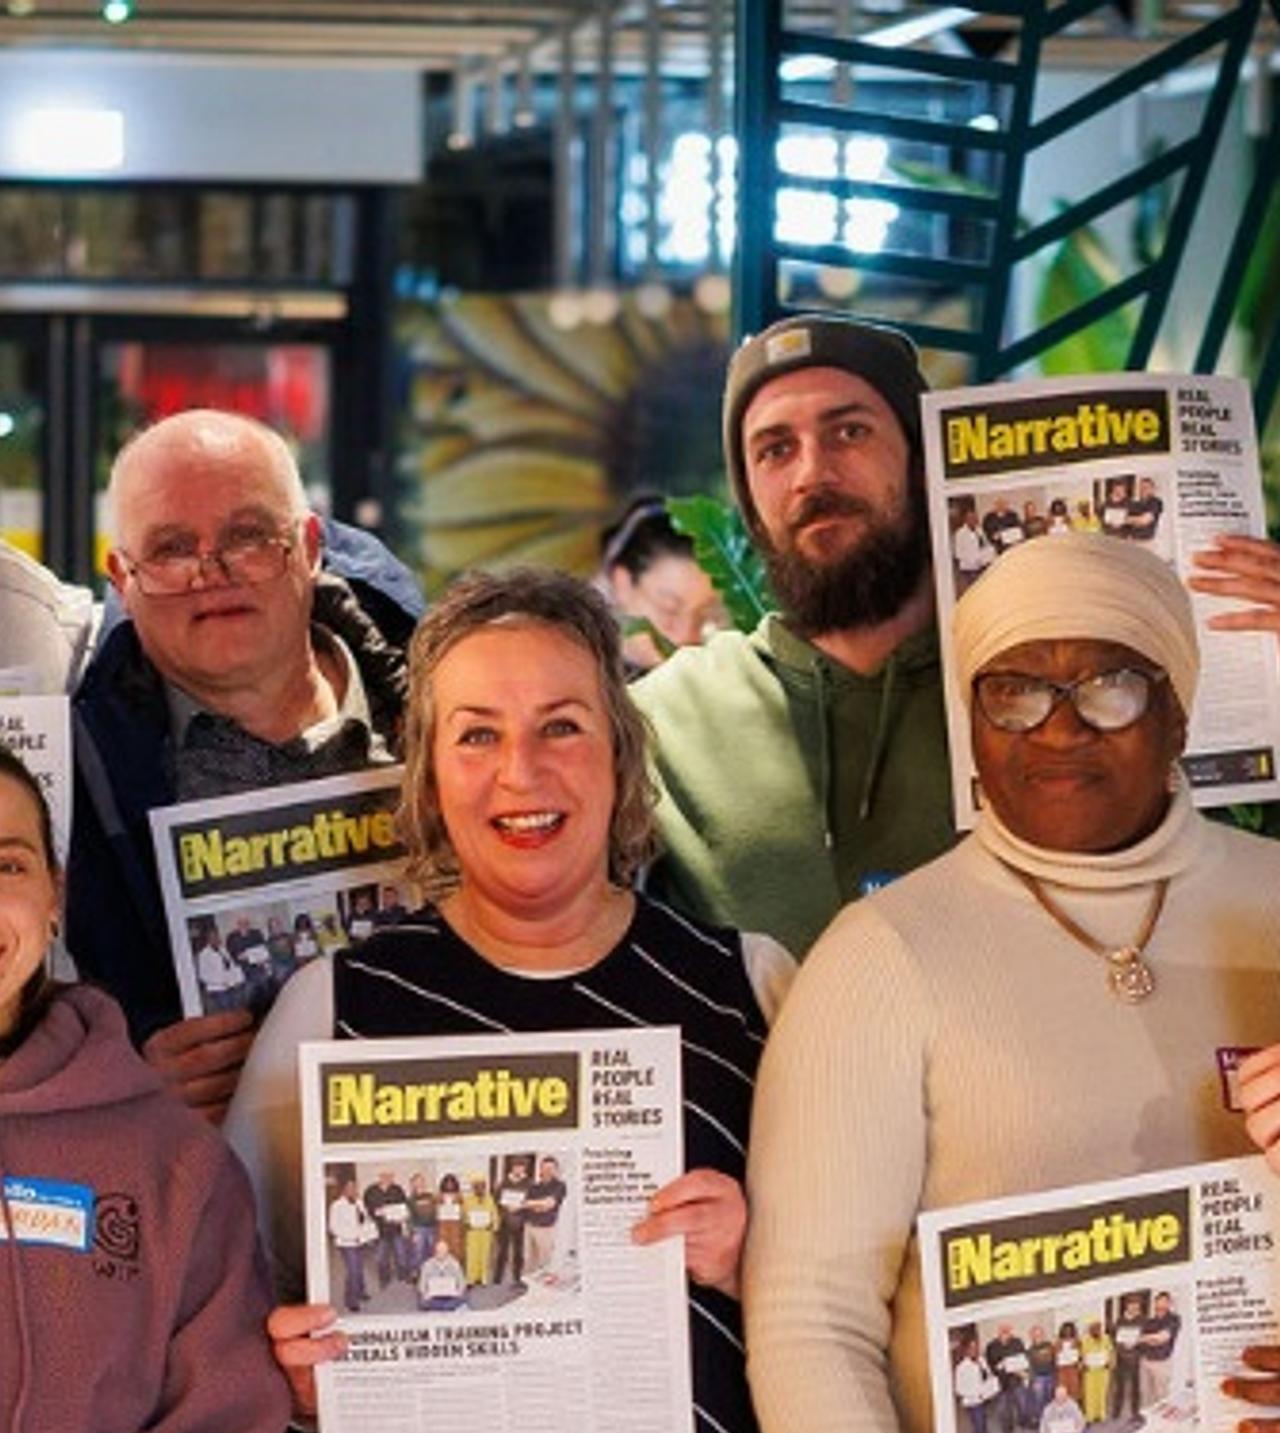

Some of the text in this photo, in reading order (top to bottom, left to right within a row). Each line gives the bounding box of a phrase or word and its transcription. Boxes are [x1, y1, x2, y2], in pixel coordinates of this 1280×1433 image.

[960, 404, 1159, 462] Narrative
[191, 809, 396, 880] Narrative
[591, 1050, 631, 1067] REAL
[592, 1068, 655, 1086] PEOPLE
[340, 1071, 569, 1126] Narrative
[592, 1089, 632, 1106] REAL
[592, 1108, 663, 1128] STORIES
[1200, 1180, 1241, 1197] REAL
[1201, 1194, 1262, 1217] PEOPLE
[1204, 1218, 1244, 1235] REAL
[960, 1215, 1180, 1289] Narrative
[1204, 1234, 1275, 1258] STORIES
[435, 1323, 510, 1341] TRAINING
[513, 1319, 583, 1337] PROJECT
[405, 1344, 464, 1359] HIDDEN
[467, 1341, 520, 1357] SKILLS
